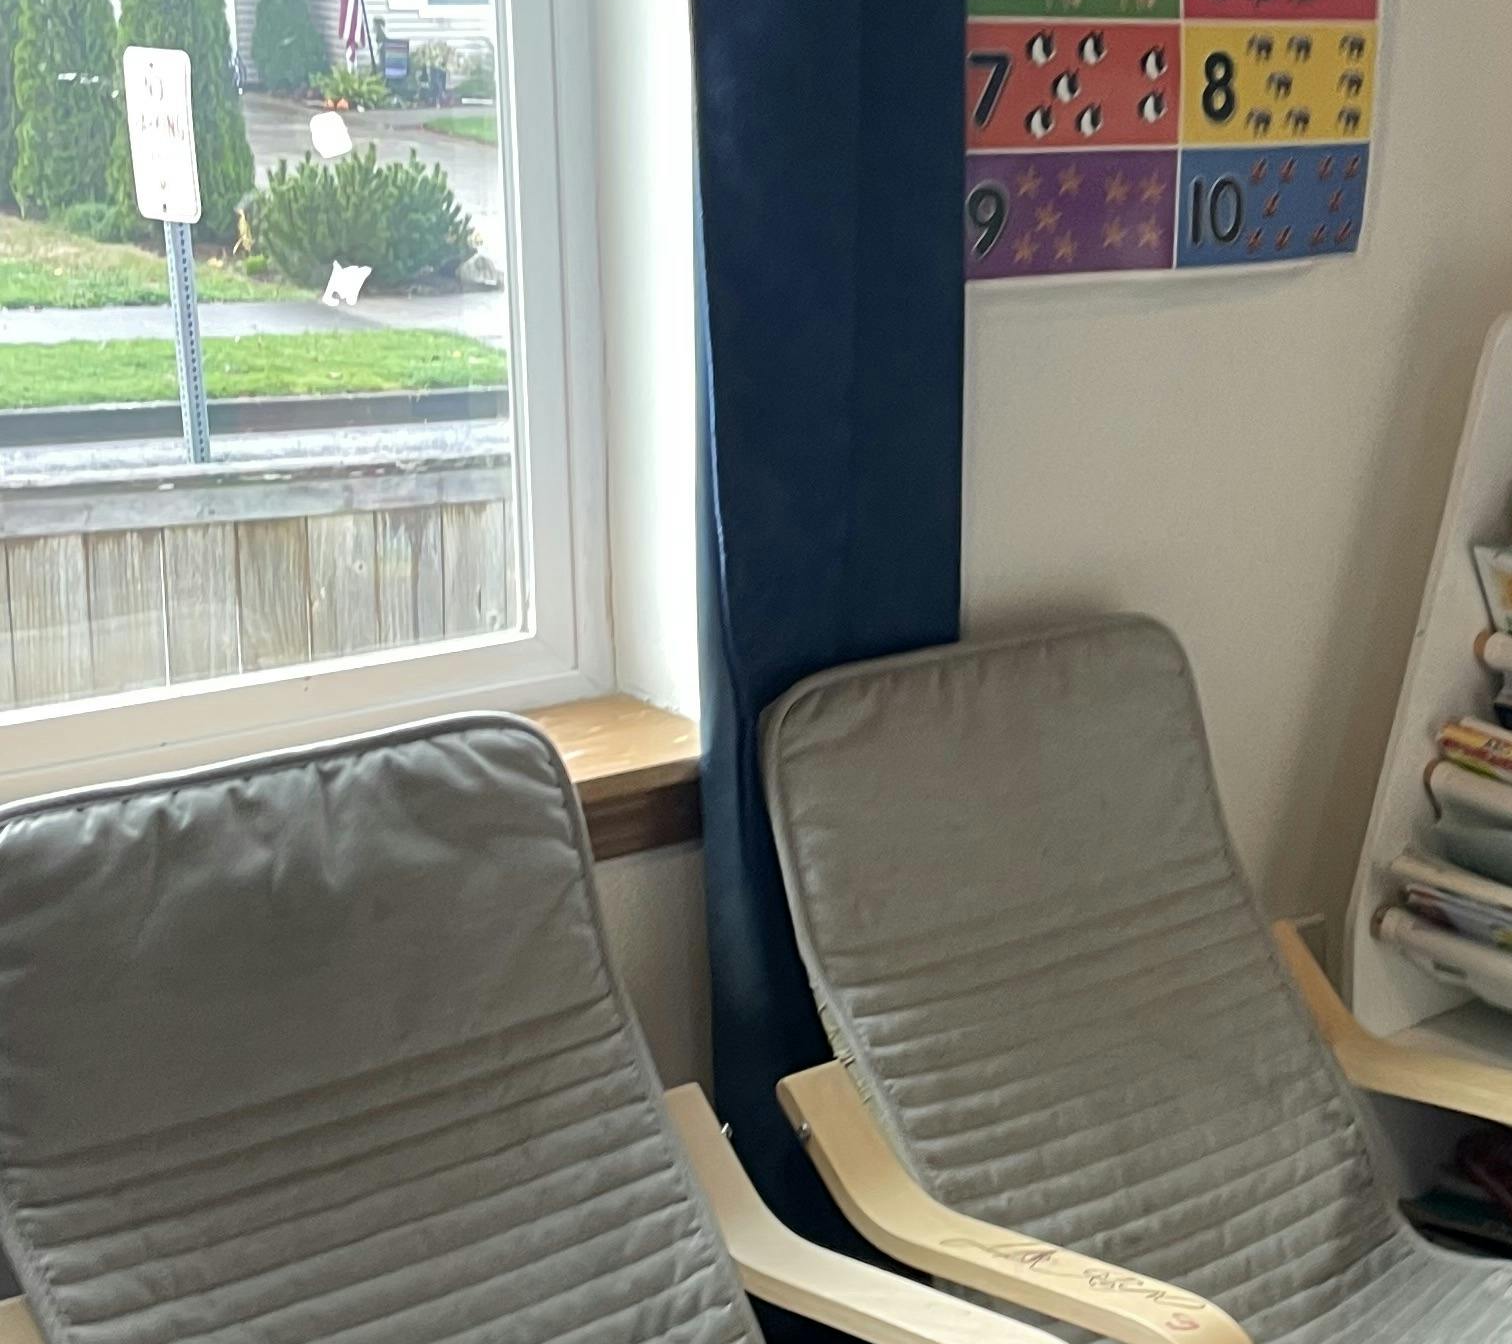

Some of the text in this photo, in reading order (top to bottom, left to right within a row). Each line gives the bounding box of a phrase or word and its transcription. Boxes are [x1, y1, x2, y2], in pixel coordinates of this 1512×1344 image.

[967, 51, 1015, 134] 7
[1200, 51, 1237, 127] 8
[966, 181, 1011, 262] 9
[1188, 172, 1248, 249] 10
